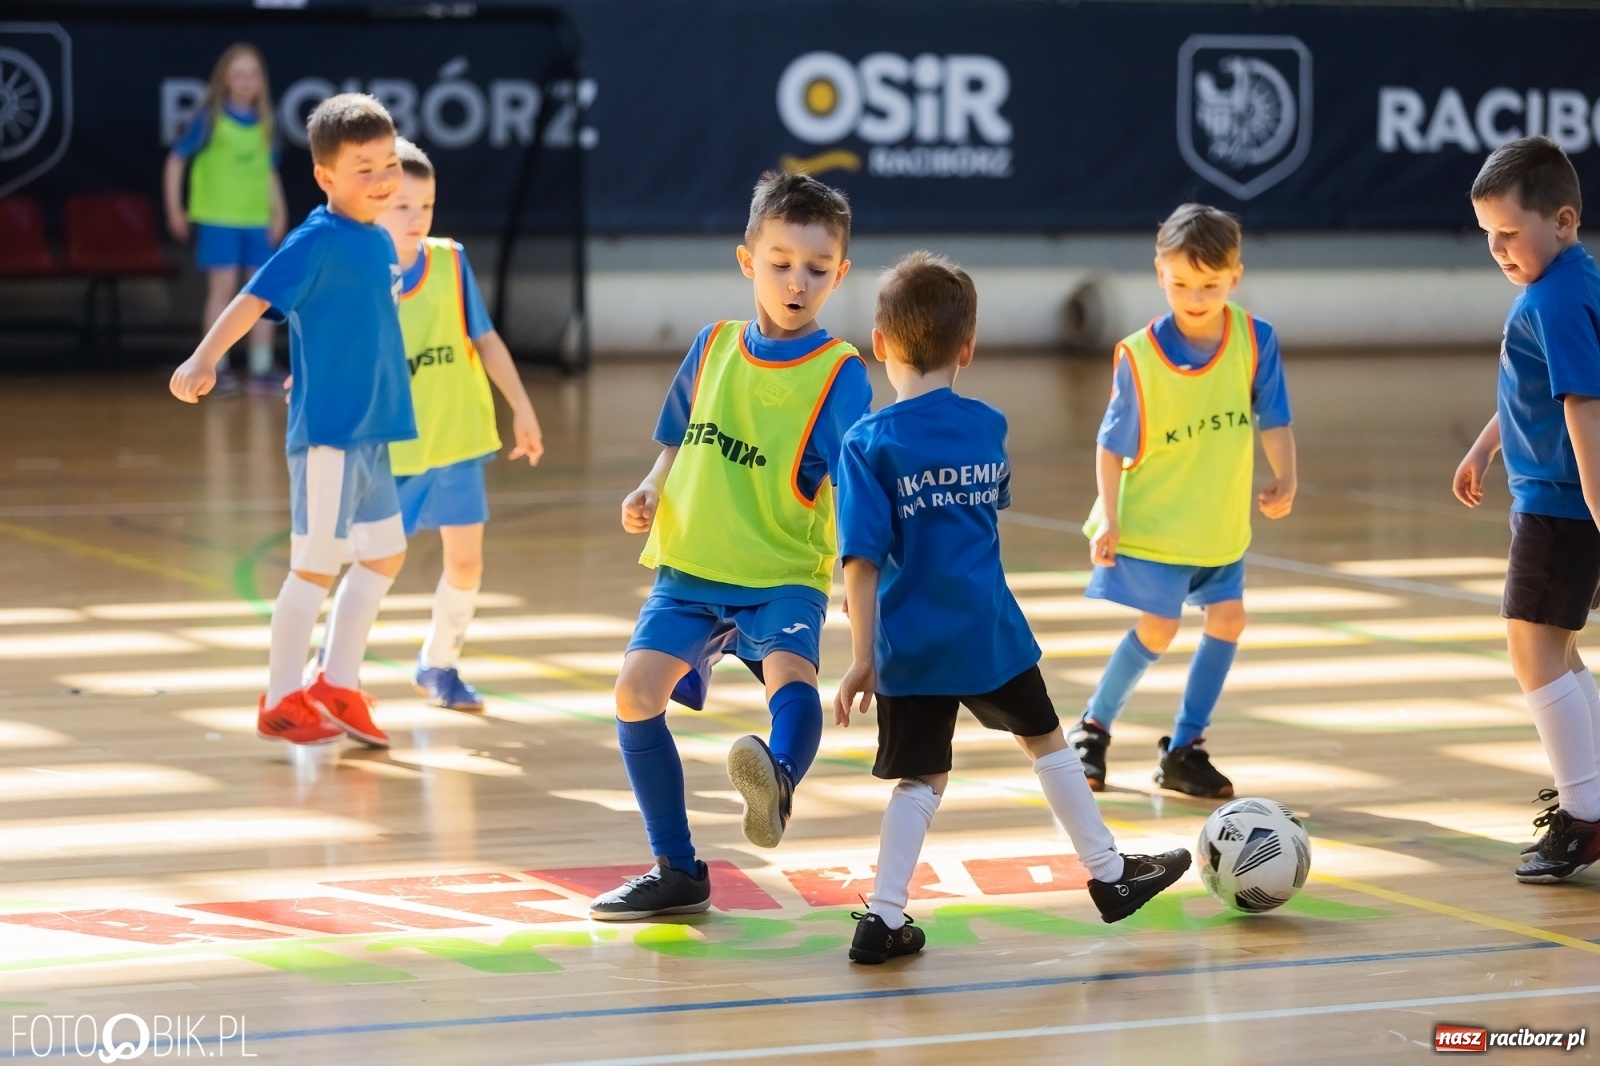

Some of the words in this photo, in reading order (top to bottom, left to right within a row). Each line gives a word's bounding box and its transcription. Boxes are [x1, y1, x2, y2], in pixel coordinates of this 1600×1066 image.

[160, 56, 599, 149] RCBÓRZ
[1377, 85, 1600, 154] RACIB
[1166, 411, 1249, 444] KIPSTA
[932, 487, 999, 507] RACIBÓR
